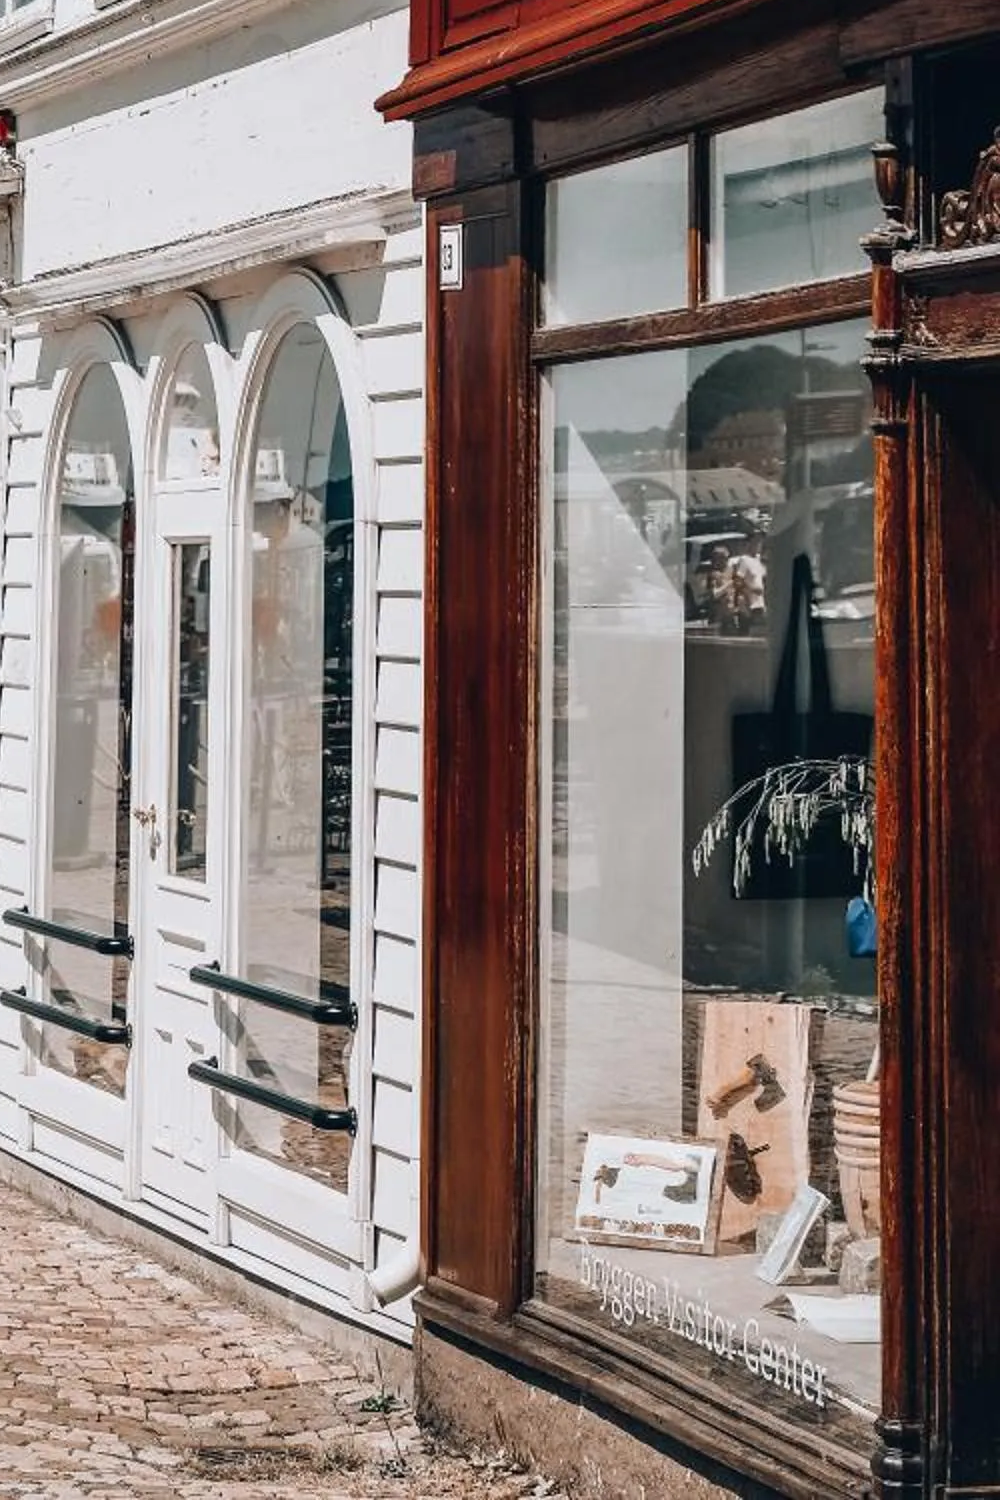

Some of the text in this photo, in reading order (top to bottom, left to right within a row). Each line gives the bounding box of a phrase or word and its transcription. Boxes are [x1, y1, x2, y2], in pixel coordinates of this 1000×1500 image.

[580, 1239, 827, 1408] Bryggen Visitor Center
